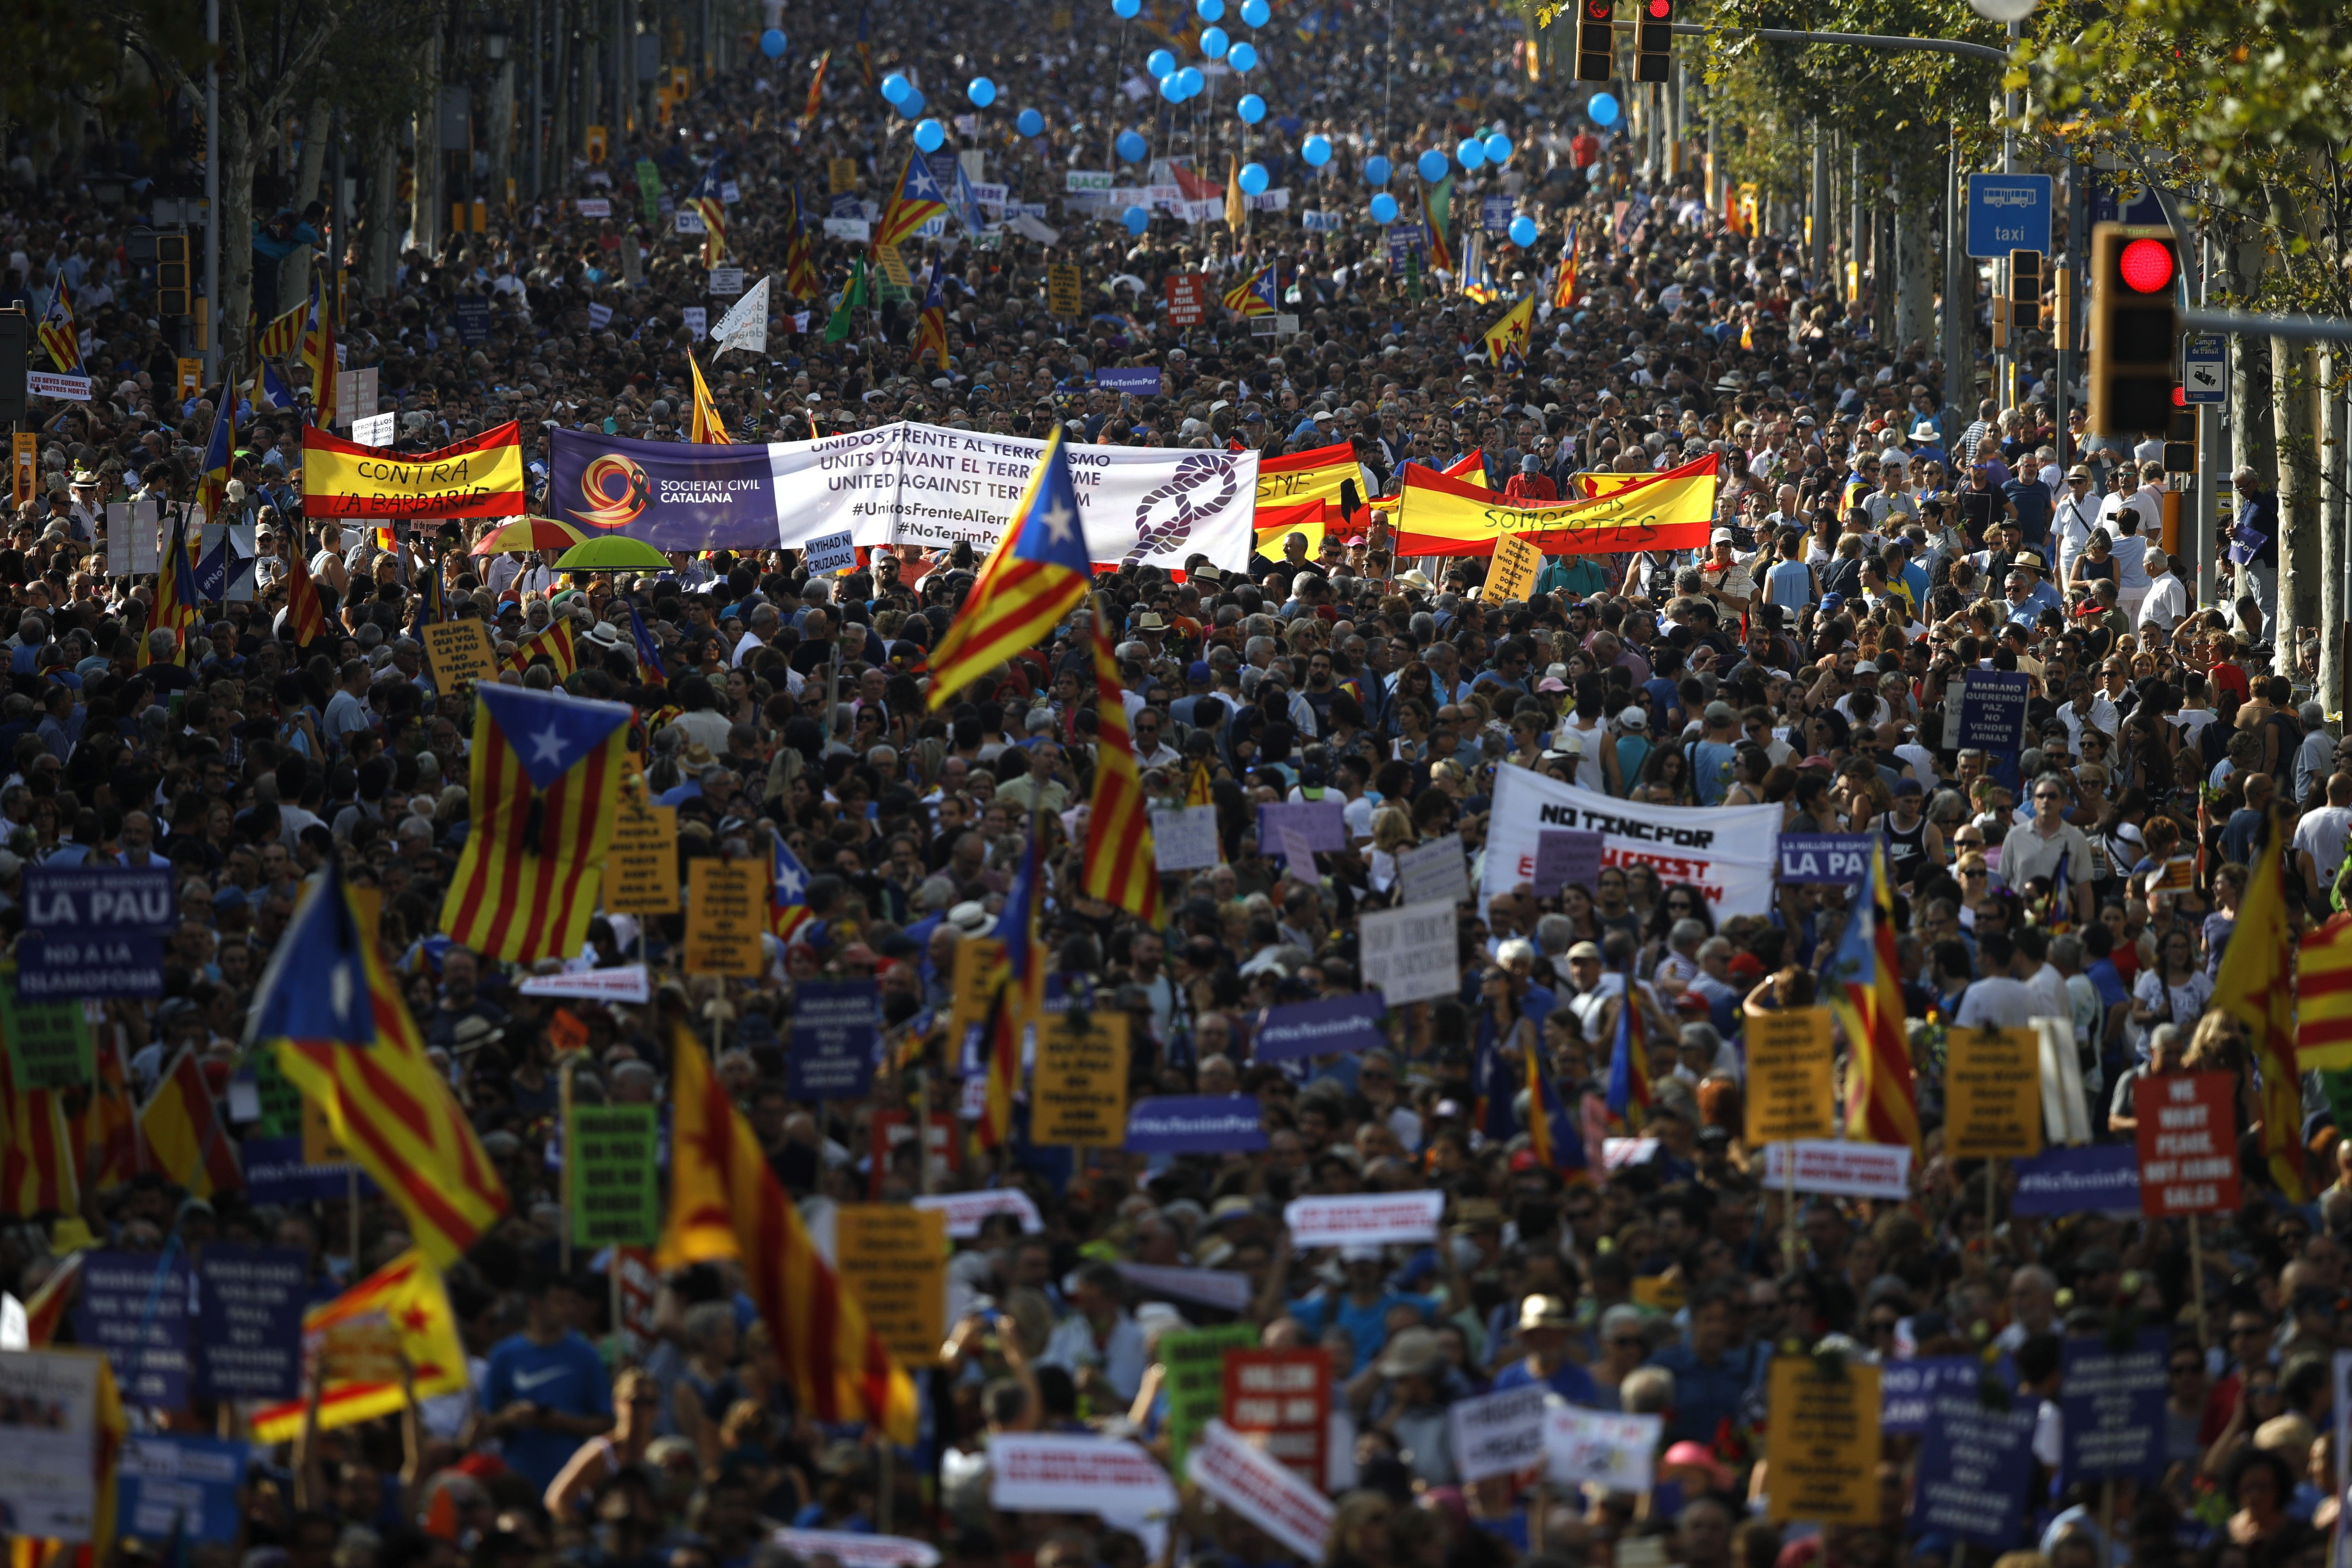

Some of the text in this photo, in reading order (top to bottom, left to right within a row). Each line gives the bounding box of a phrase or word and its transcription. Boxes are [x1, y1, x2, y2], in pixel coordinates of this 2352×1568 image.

[916, 220, 942, 235] AU
[1995, 225, 2024, 241] taxi
[1179, 277, 1188, 285] WE
[1176, 315, 1196, 324] SALES
[41, 384, 67, 393] NOSTRES
[1099, 377, 1157, 387] #NoTenimPor
[354, 417, 392, 432] ATROPELLOS
[374, 434, 393, 443] primero?
[812, 429, 1110, 467] UNIDOS FRENTE AL TERROSMO
[821, 451, 874, 470] UNITS
[882, 450, 955, 469] DAVANT
[962, 458, 980, 473] EL
[358, 459, 468, 484] CONTRA
[661, 478, 760, 491] SOCIETAT CIVIL
[828, 473, 894, 491] UNITED
[899, 474, 982, 496] AGAINST
[334, 491, 361, 513] LA
[661, 493, 732, 503] CATALANA
[897, 521, 1005, 545] #NoTenimPo
[806, 533, 852, 555] NI YIHAD NI
[1509, 539, 1530, 554] FELIPE,
[809, 552, 854, 573] CRUZADAS.
[1505, 548, 1529, 564] PEOPLE
[1497, 555, 1533, 575] WHO WANT
[1500, 575, 1519, 588] DON'T
[1501, 567, 1522, 581] PEACE
[1494, 583, 1510, 595] DEAL
[433, 637, 453, 647] QUI
[438, 643, 478, 655] LA PAU
[451, 654, 468, 662] NO
[439, 661, 488, 673] TRAFICA
[455, 671, 478, 680] AMB
[1972, 680, 2022, 693] MARIANO
[1966, 692, 2025, 703] QUEREMOS
[1982, 703, 2005, 711] PAZ,
[1984, 713, 2001, 722] NO
[1970, 723, 2012, 732] VENDER
[1971, 733, 2009, 742] ARMAS
[1540, 803, 1714, 850] NO TINC POR
[1782, 852, 1866, 876] LA PA
[30, 891, 170, 925] LA PAU
[43, 943, 133, 964] NO A LA
[2168, 1079, 2197, 1102] WE
[2158, 1106, 2209, 1130] WANT
[2143, 1157, 2233, 1185] NOT ARMS
[2162, 1185, 2219, 1209] SALES
